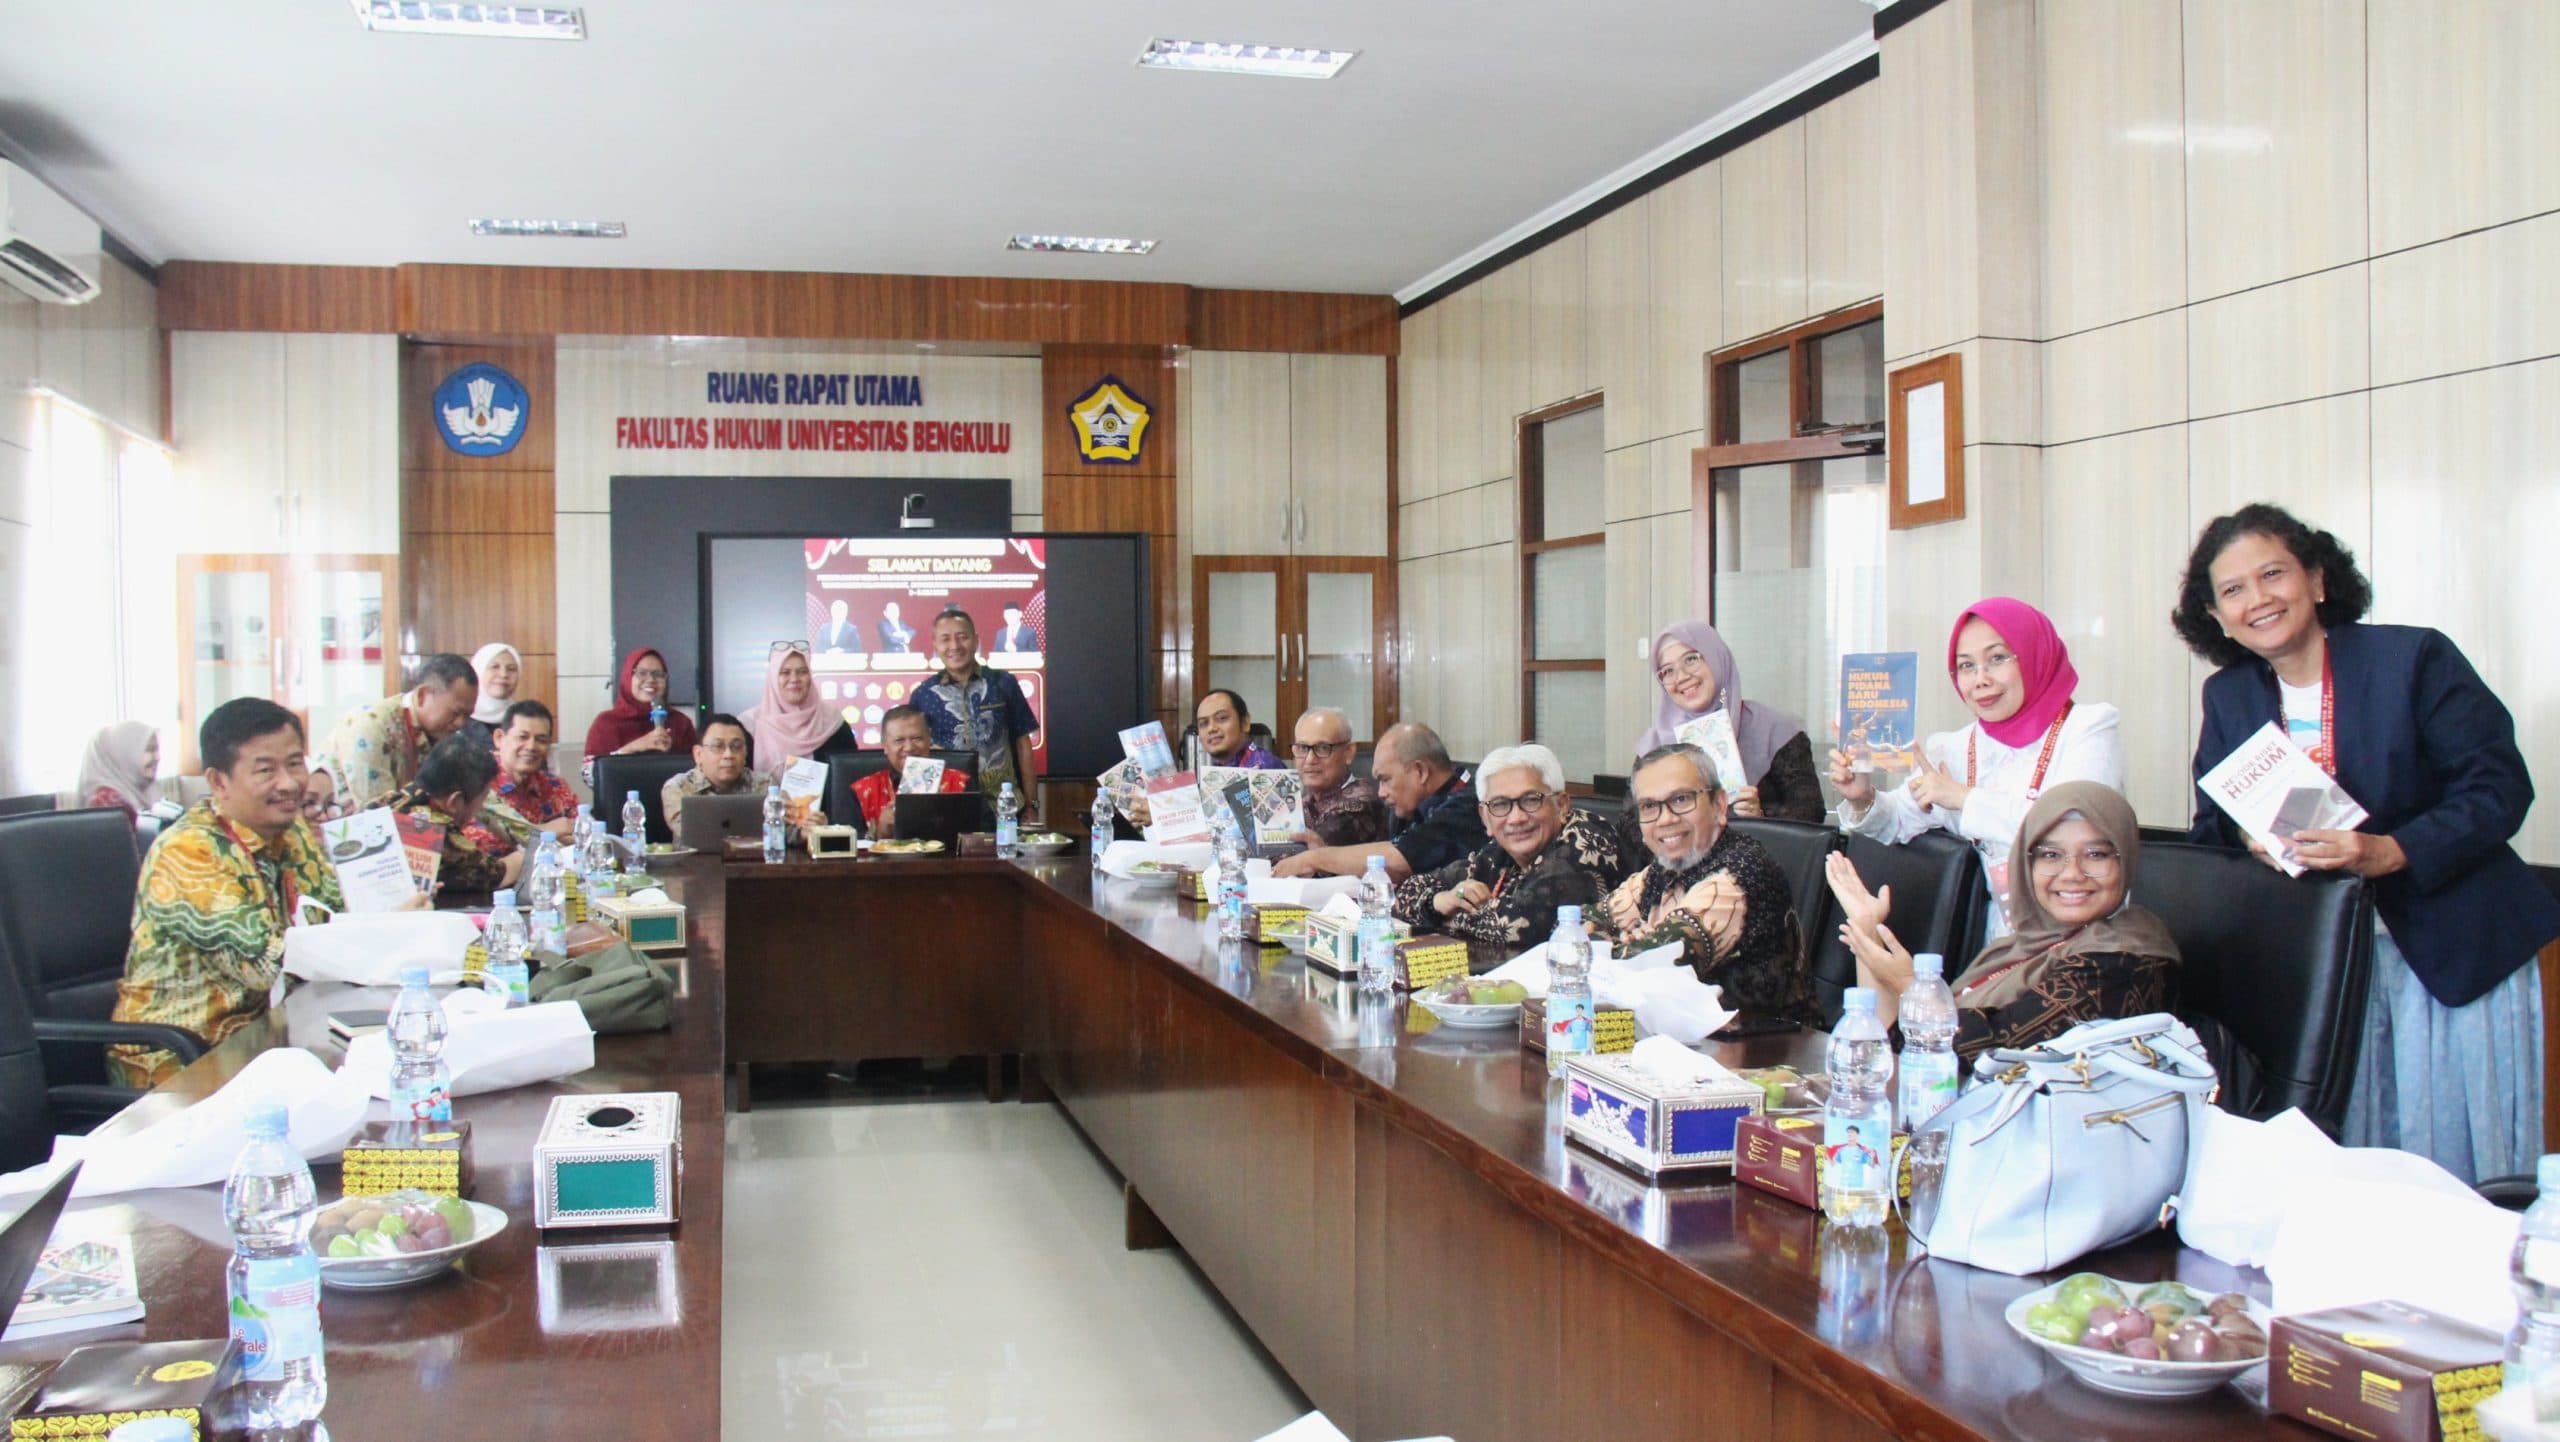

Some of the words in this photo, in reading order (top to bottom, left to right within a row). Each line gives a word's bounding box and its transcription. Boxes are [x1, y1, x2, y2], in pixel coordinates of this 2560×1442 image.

[707, 372, 778, 404] RUANG
[784, 374, 849, 405] RAPAT
[854, 375, 922, 407] UTAMA
[616, 417, 708, 450] FAKULTAS
[714, 418, 782, 450] HUKUM
[787, 419, 909, 452] UNIVERSITAS
[913, 421, 1011, 454] BENGKULU
[867, 558, 931, 573] SELAMAT
[932, 558, 992, 573] DATANG
[1848, 672, 1890, 681] HUKUM
[1847, 681, 1891, 690] PIDANA
[1847, 690, 1879, 699] BARU
[1847, 699, 1908, 709] INDONESIA
[2228, 746, 2287, 799] HUKUM
